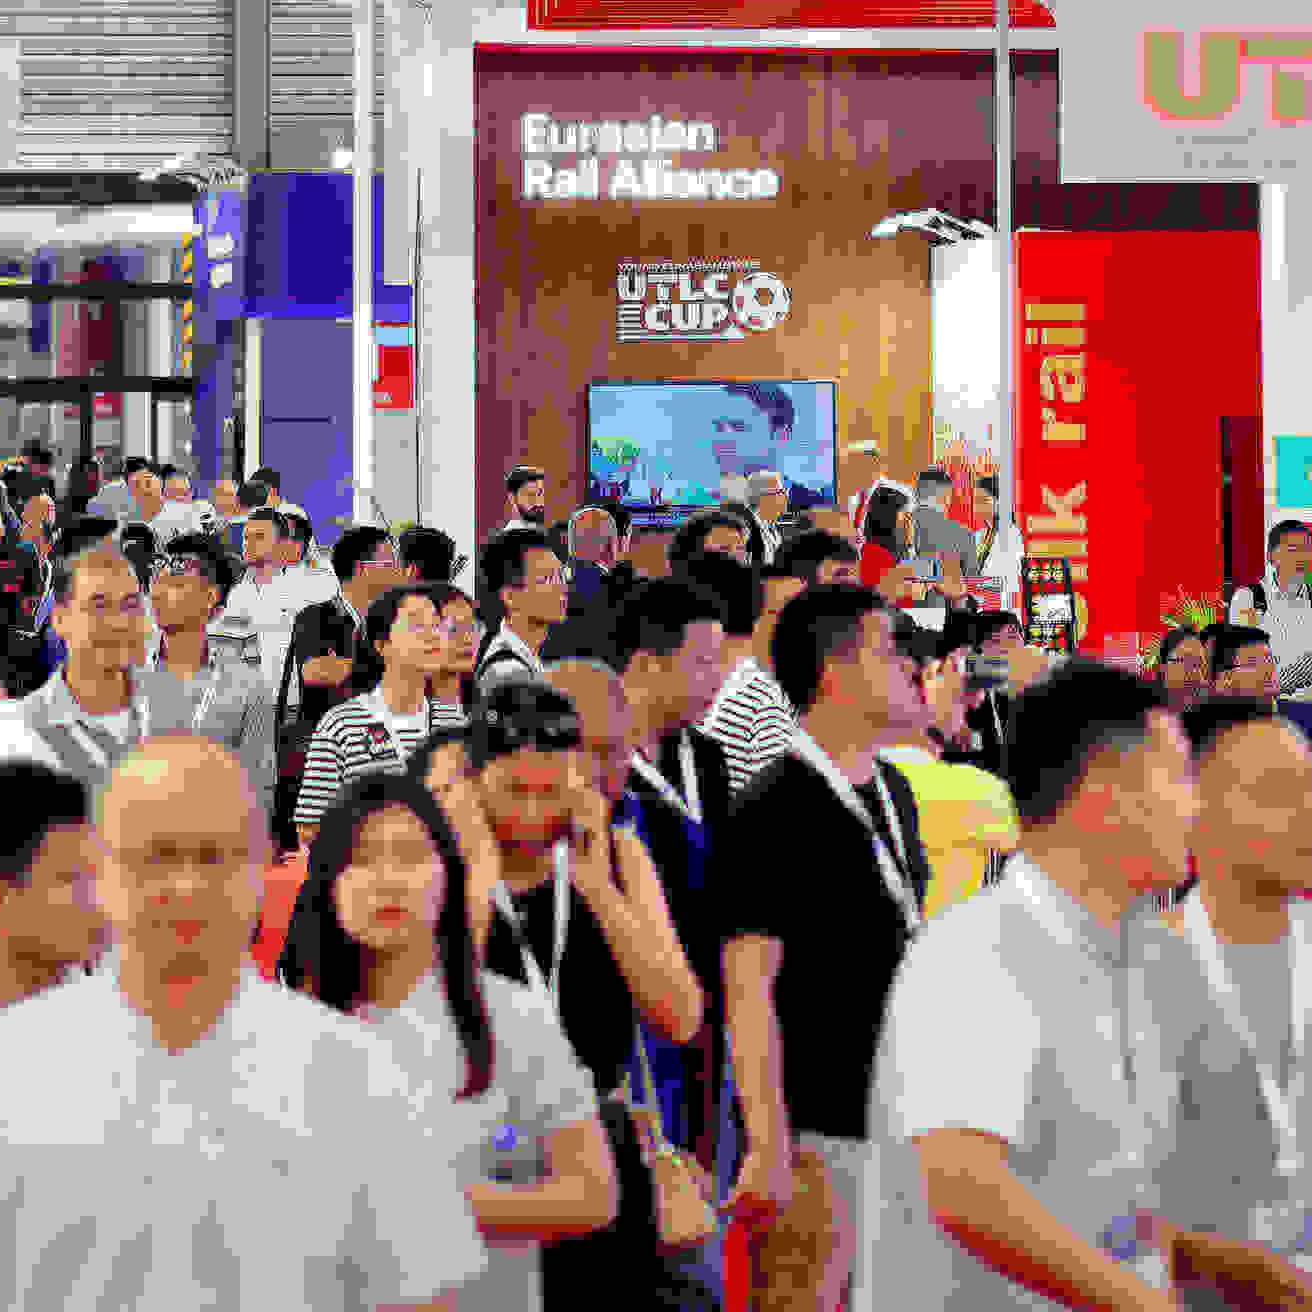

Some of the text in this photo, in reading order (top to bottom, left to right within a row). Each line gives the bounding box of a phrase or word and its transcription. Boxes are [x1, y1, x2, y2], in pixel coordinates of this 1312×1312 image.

[520, 112, 720, 152] Eurasian
[520, 158, 778, 201] Rail Alliance
[617, 272, 730, 302] UTLC
[646, 303, 730, 331] CUP
[1024, 302, 1088, 441] rail
